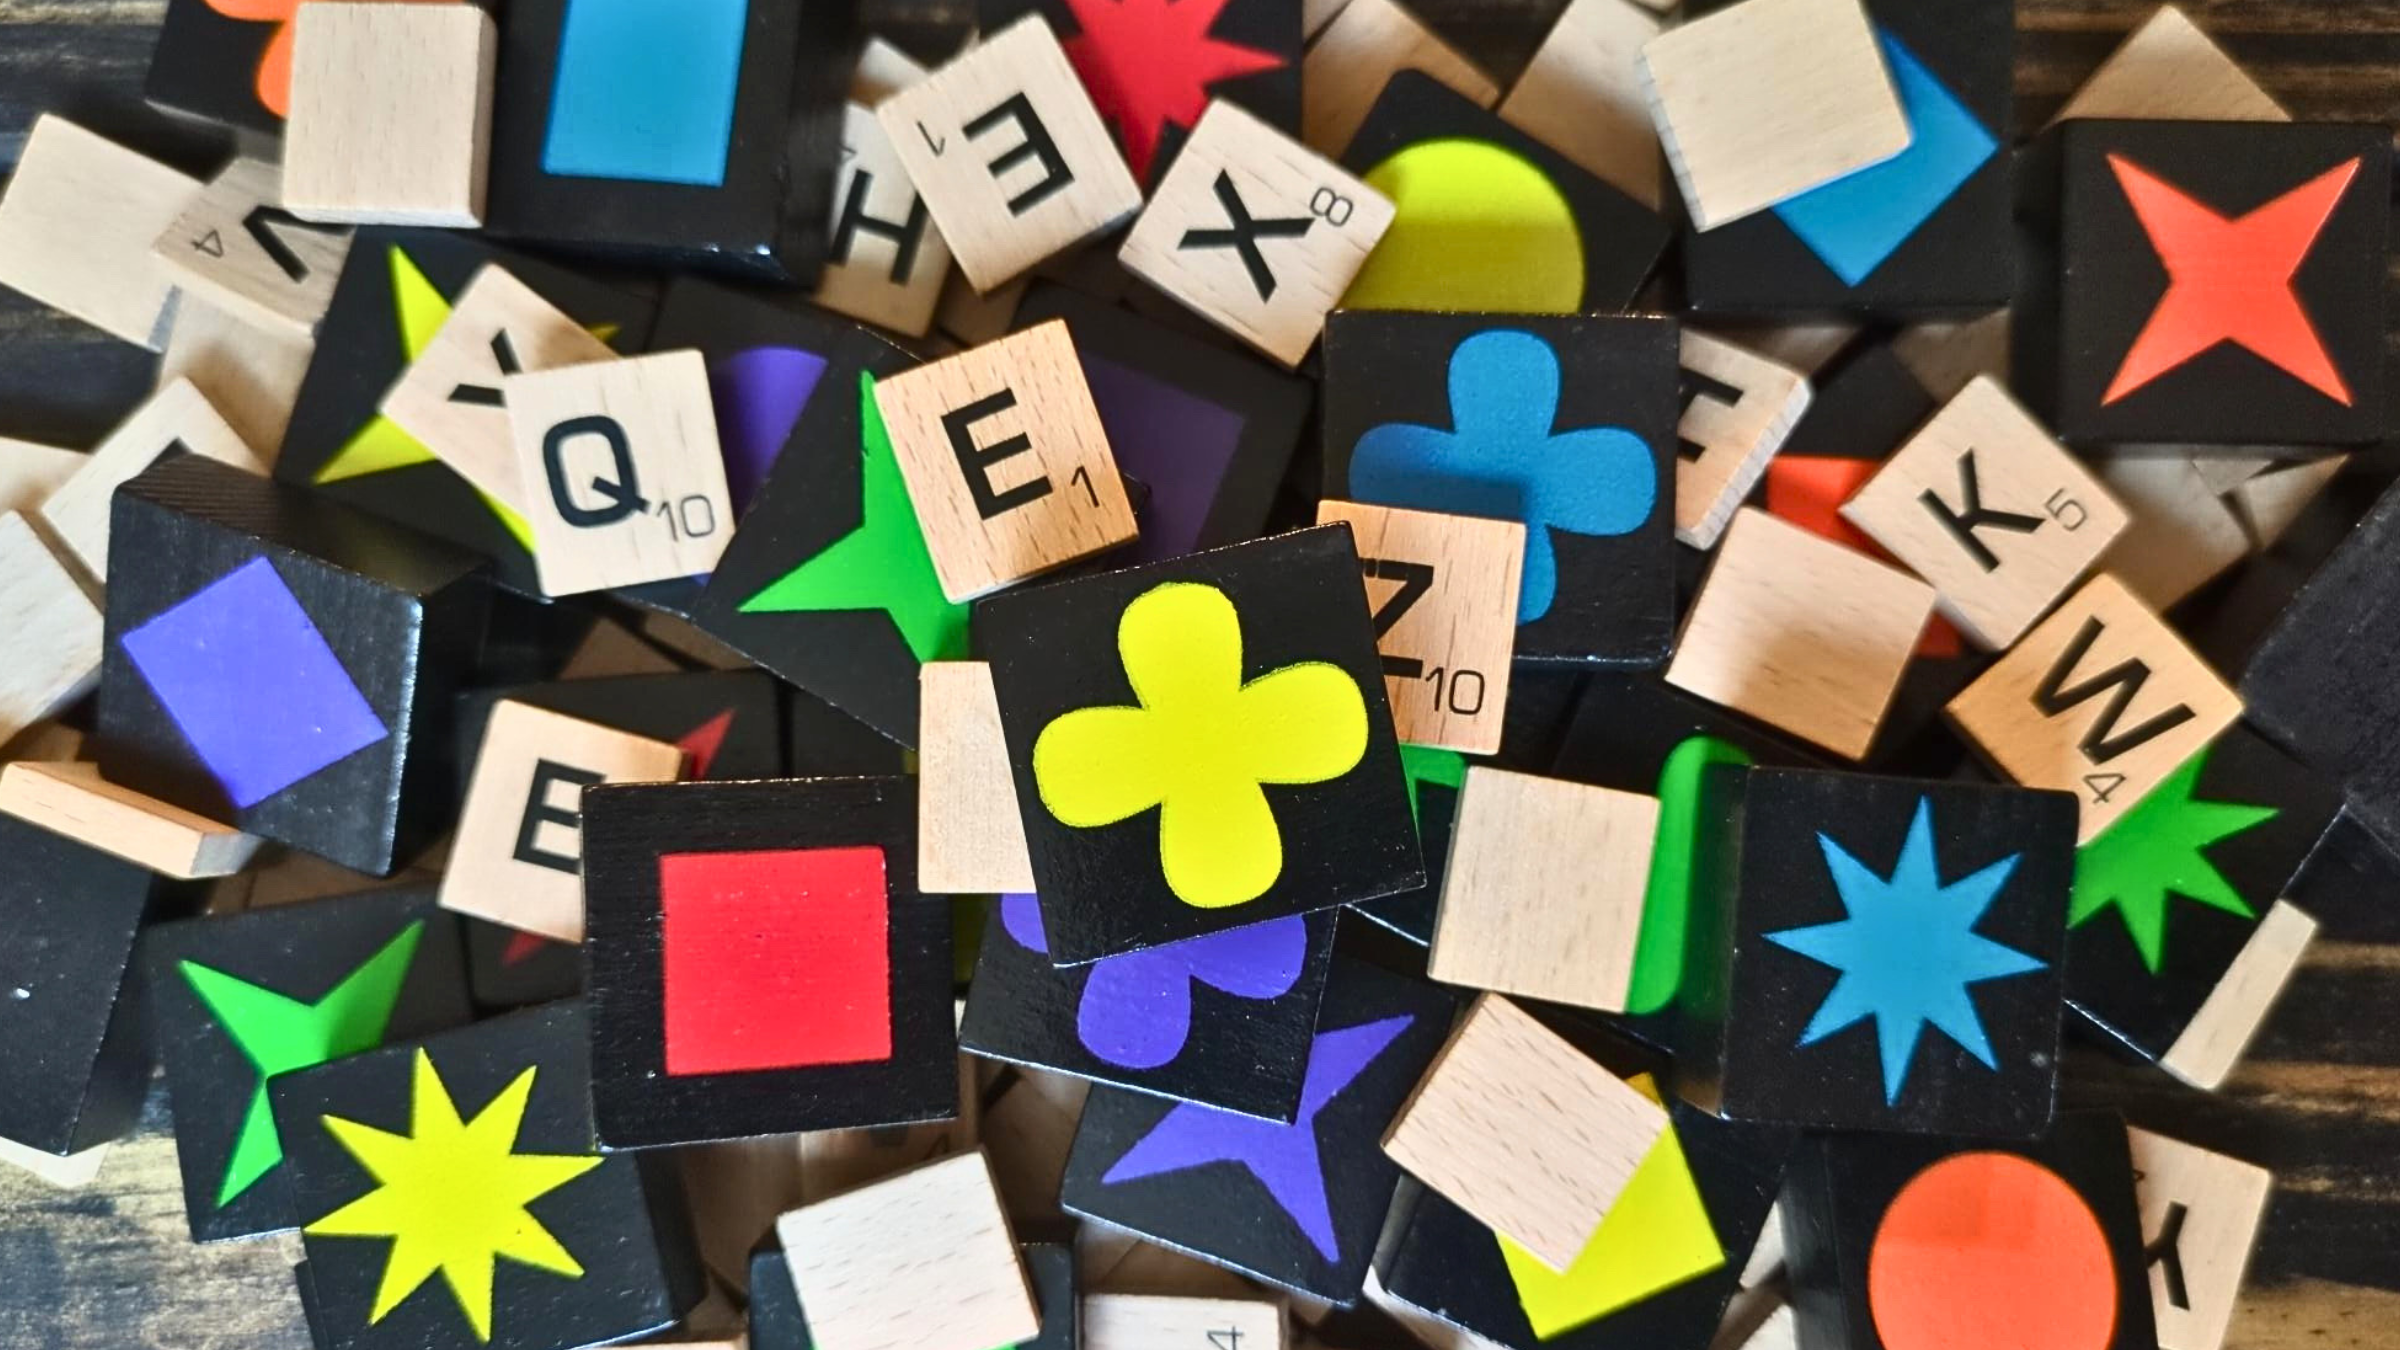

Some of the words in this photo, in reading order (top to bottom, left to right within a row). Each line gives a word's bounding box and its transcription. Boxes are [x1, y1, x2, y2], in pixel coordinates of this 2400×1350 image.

[916, 120, 946, 157] 1
[961, 91, 1075, 218] E
[190, 227, 225, 258] 4
[242, 205, 354, 284] V
[827, 168, 930, 286] H
[1177, 168, 1315, 304] X
[1309, 187, 1353, 227] 8
[543, 415, 650, 527] Q
[657, 495, 716, 542] 10
[940, 387, 1054, 521] E
[1070, 465, 1100, 509] 1
[1917, 448, 2046, 574] K
[2043, 488, 2088, 532] 5
[1358, 557, 1435, 678] Z
[1425, 667, 1486, 716] 10
[2030, 615, 2197, 766] W
[512, 758, 607, 876] E
[2082, 773, 2127, 804] 4
